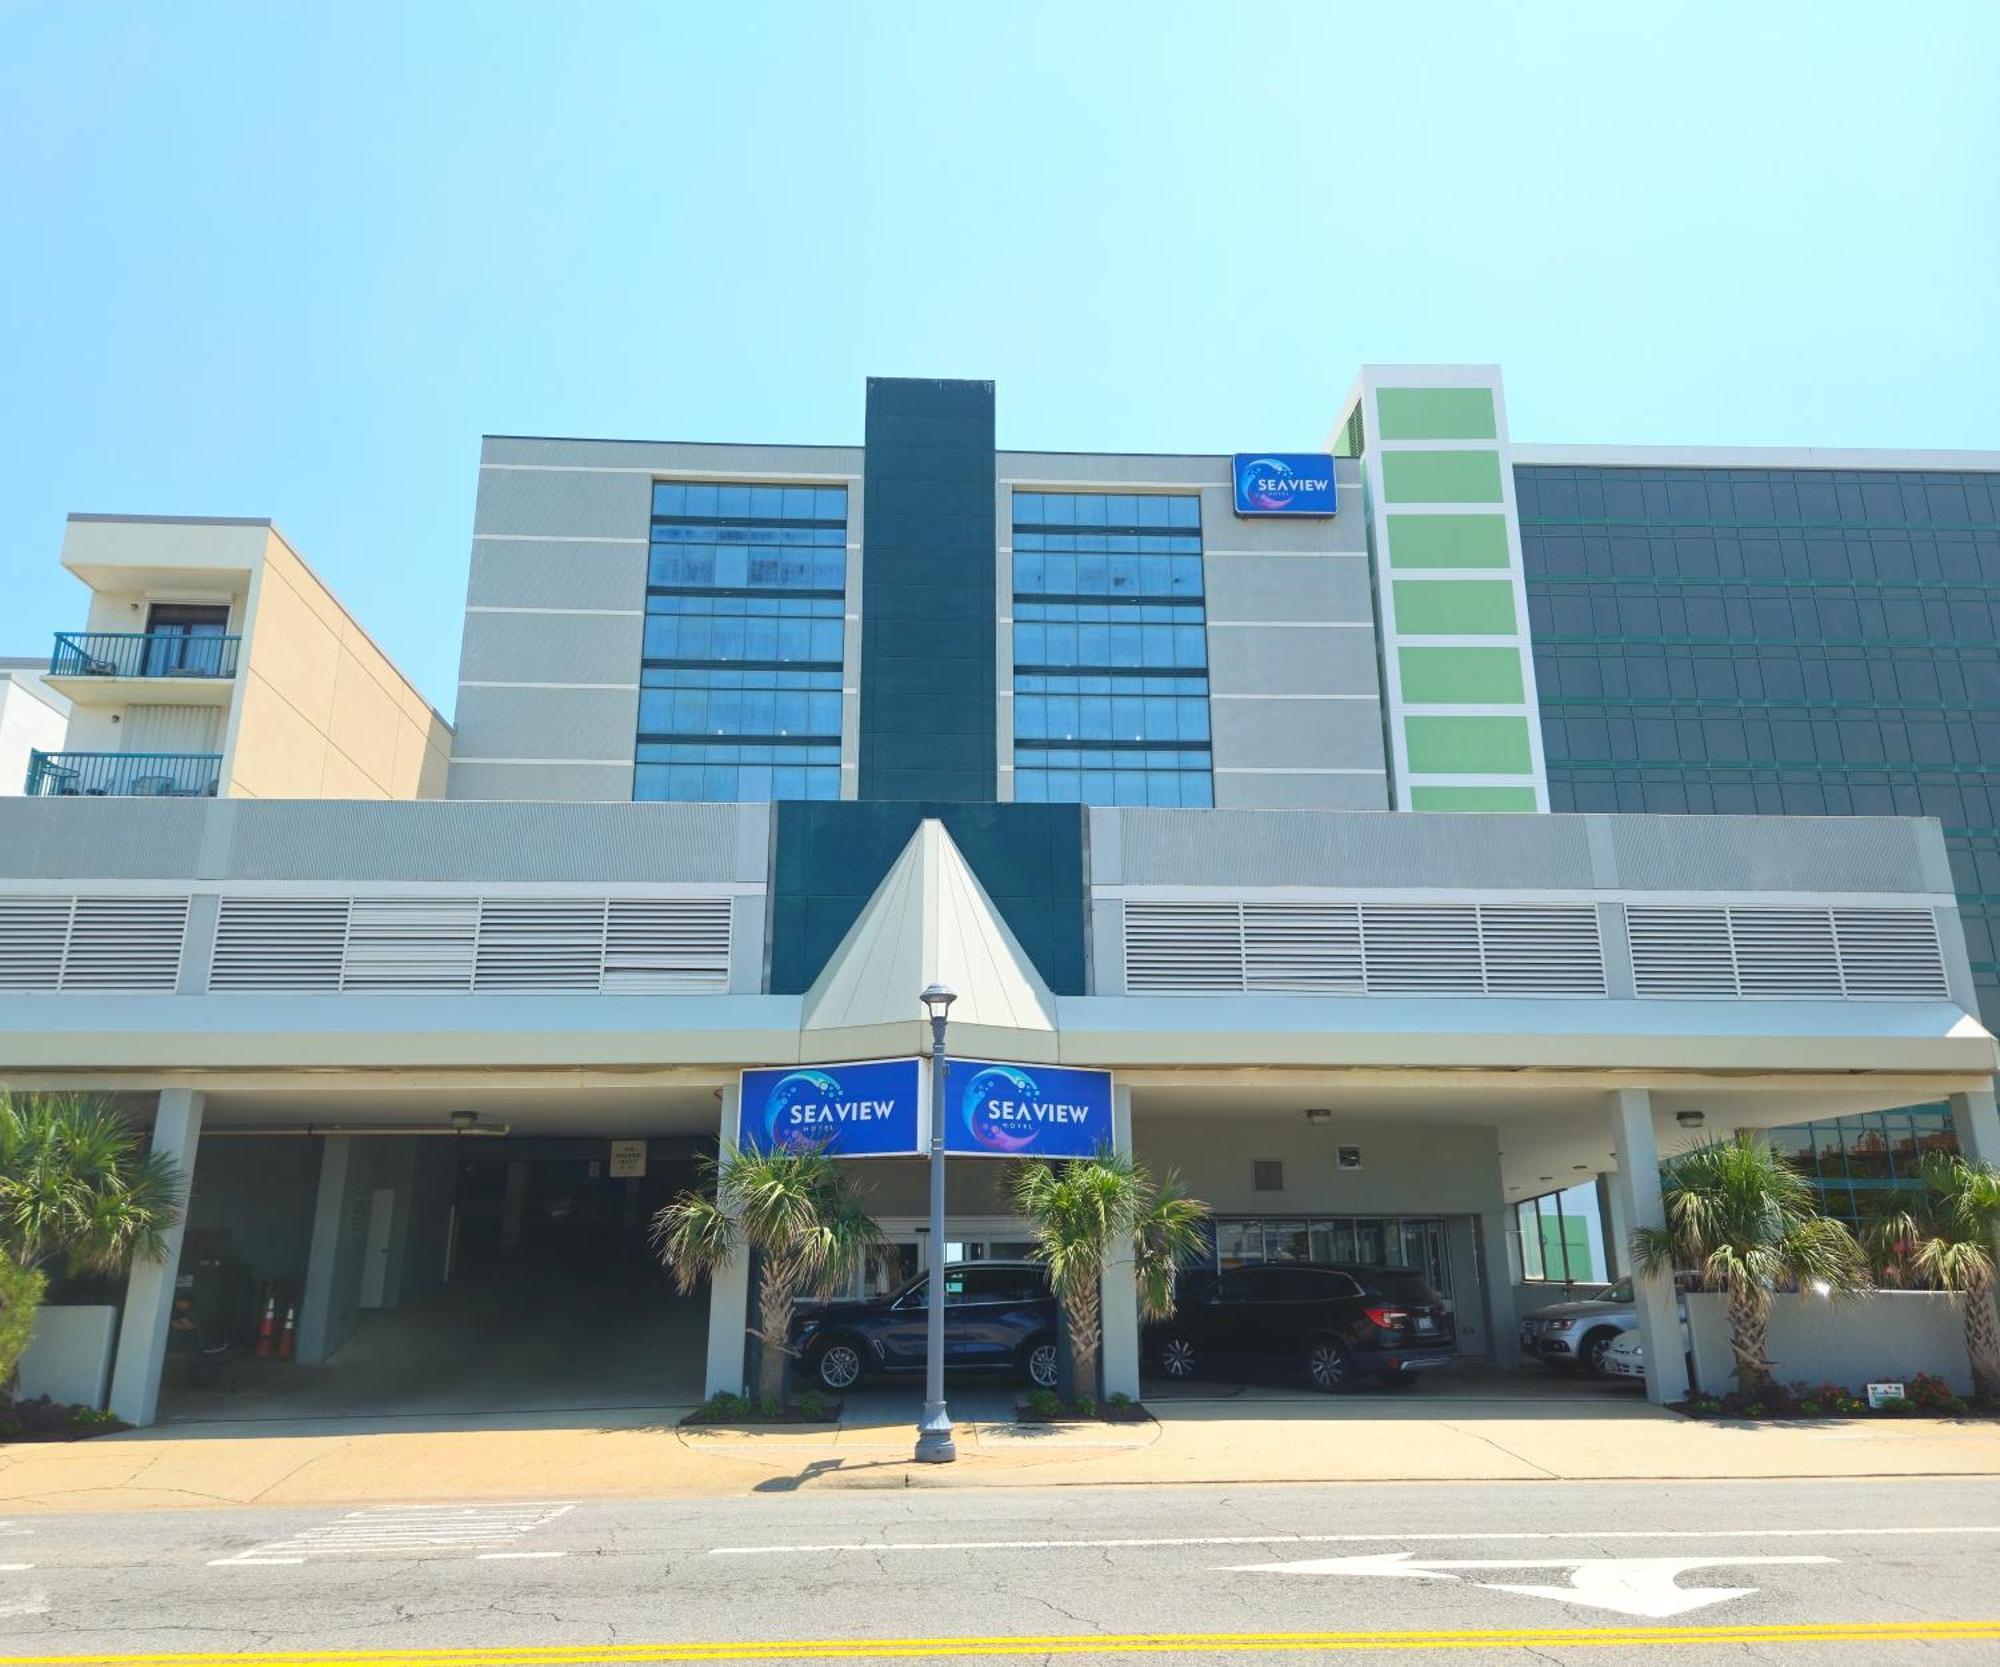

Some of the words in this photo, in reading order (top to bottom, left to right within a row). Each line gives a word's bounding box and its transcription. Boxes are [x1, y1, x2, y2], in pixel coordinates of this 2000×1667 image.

[1258, 479, 1328, 492] SEAVIEW
[790, 1100, 895, 1124] SEAVIEW
[988, 1099, 1089, 1124] SEAVIEW
